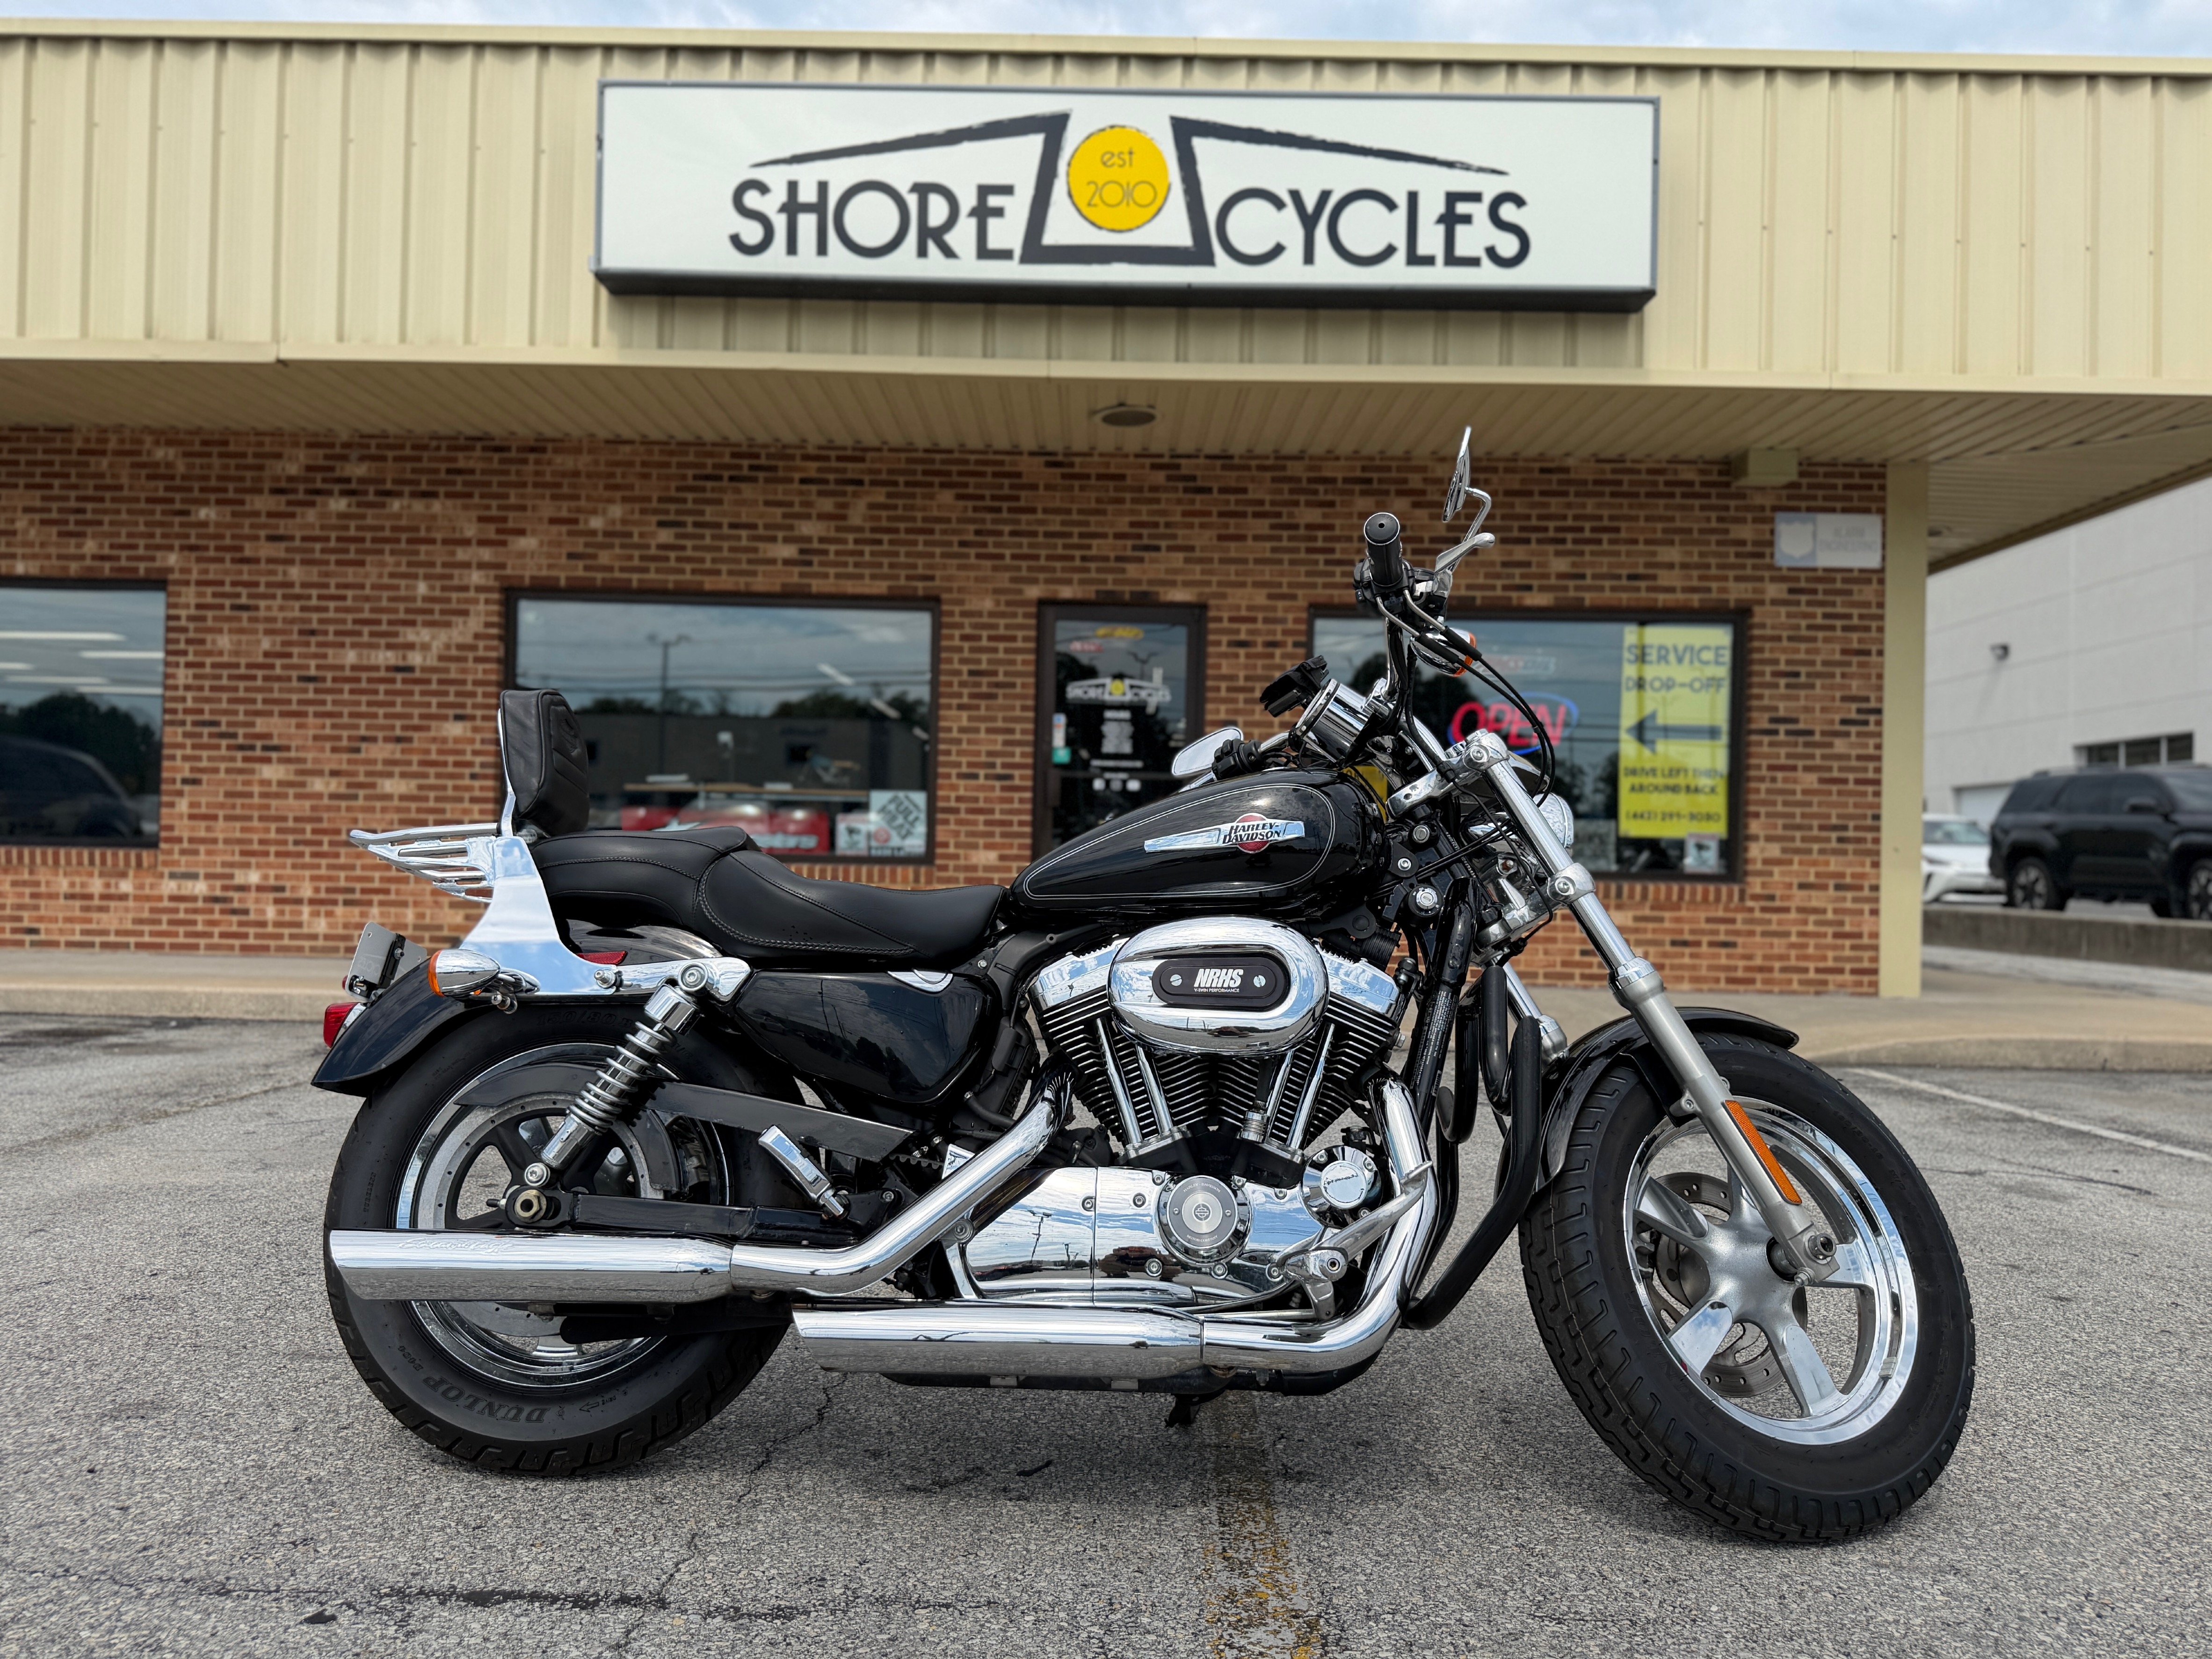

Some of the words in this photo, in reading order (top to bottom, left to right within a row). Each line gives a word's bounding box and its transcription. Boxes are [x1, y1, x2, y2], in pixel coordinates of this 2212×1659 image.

[1101, 147, 1134, 168] est
[1086, 180, 1158, 208] 2010
[729, 179, 1014, 261] SHORE
[1215, 188, 1531, 269] CYCLES
[1625, 643, 1729, 666] SERVICE
[1625, 676, 1726, 694] DROP-OFF
[1451, 700, 1567, 747] OPEN
[1624, 767, 1658, 778] DRIVE
[1661, 767, 1689, 779] LEFT
[1630, 783, 1683, 794] AROUND
[1685, 784, 1718, 795] BACK
[1222, 830, 1282, 844] DAVIDSON
[1228, 822, 1279, 835] HARLEY-
[1194, 968, 1244, 988] NRHS
[422, 1375, 551, 1424] DUNLOP
